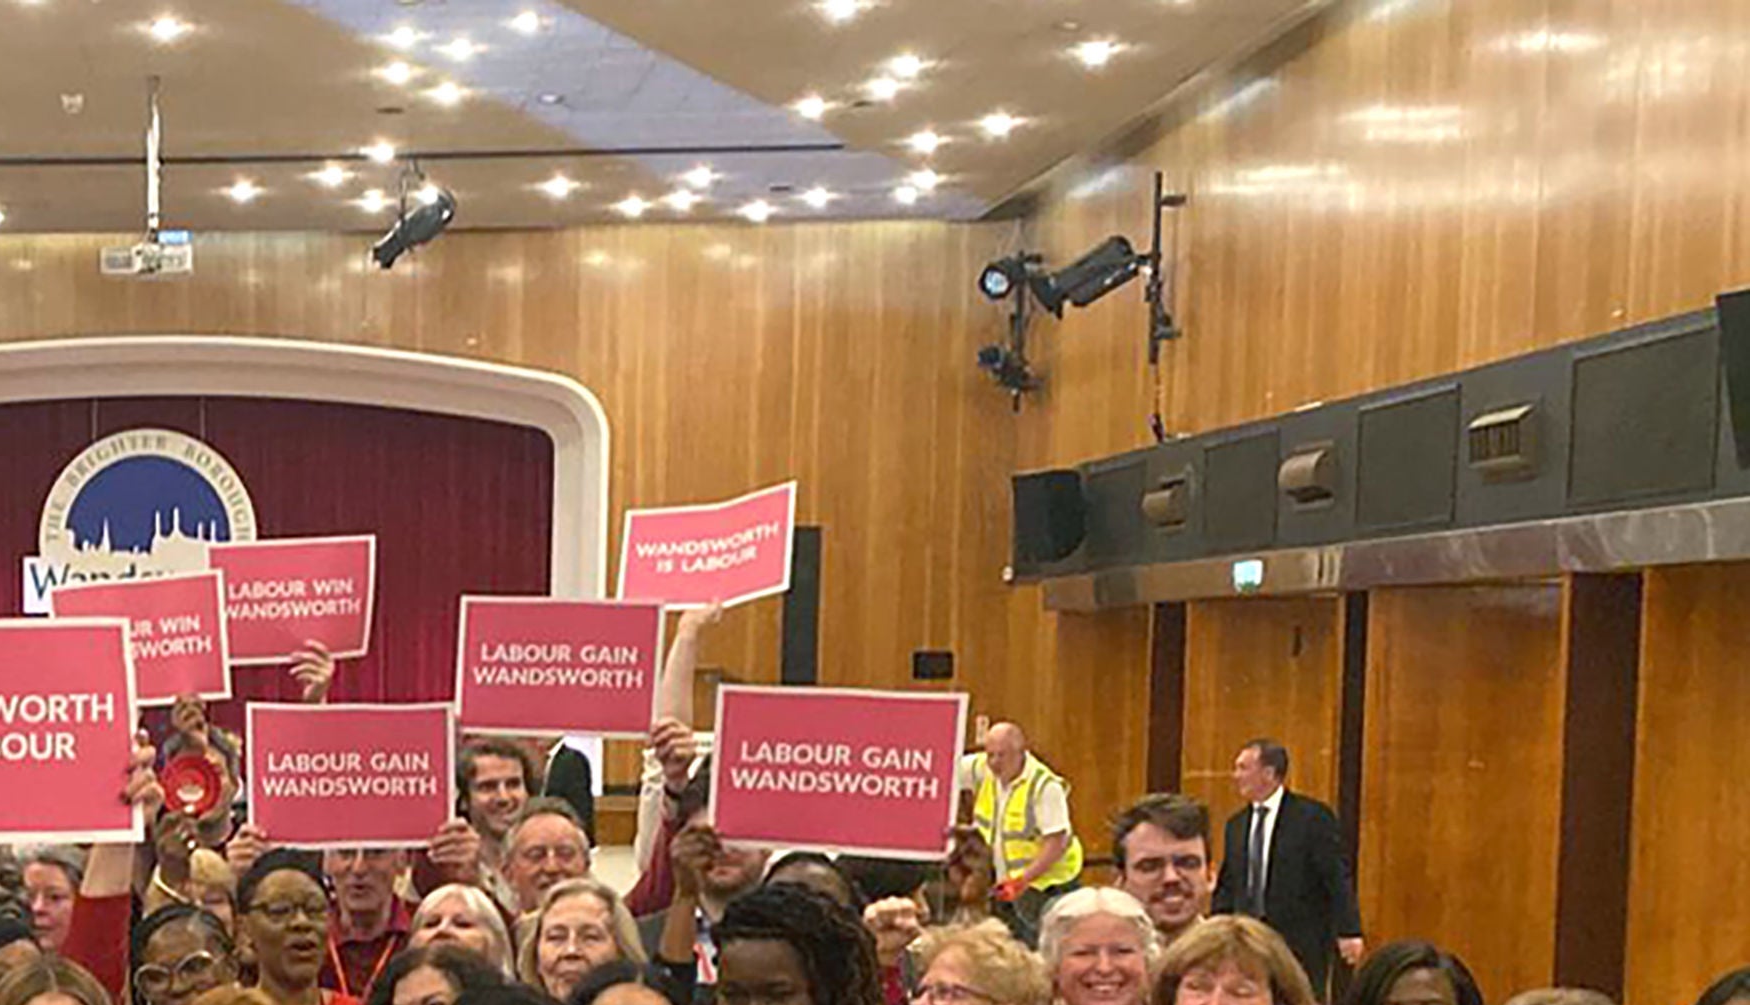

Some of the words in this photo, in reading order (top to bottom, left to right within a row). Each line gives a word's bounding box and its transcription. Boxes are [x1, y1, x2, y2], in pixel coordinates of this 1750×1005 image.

[65, 435, 168, 488] BRIGHTER
[636, 523, 779, 557] WANDSWORTH
[656, 558, 673, 573] IS
[681, 547, 758, 574] LABOUR
[228, 580, 306, 600] LABOUR
[313, 579, 353, 596] WIN
[159, 614, 200, 635] WIN
[480, 643, 573, 664] LABOUR
[580, 644, 638, 666] GAIN
[473, 666, 644, 690] WANDSWORTH
[267, 753, 363, 774] LABOUR
[370, 752, 430, 772] GAIN
[741, 741, 851, 768] LABOUR
[861, 746, 934, 773] GAIN
[262, 777, 438, 798] WANDSWORTH
[731, 768, 939, 799] WANDSWORTH
